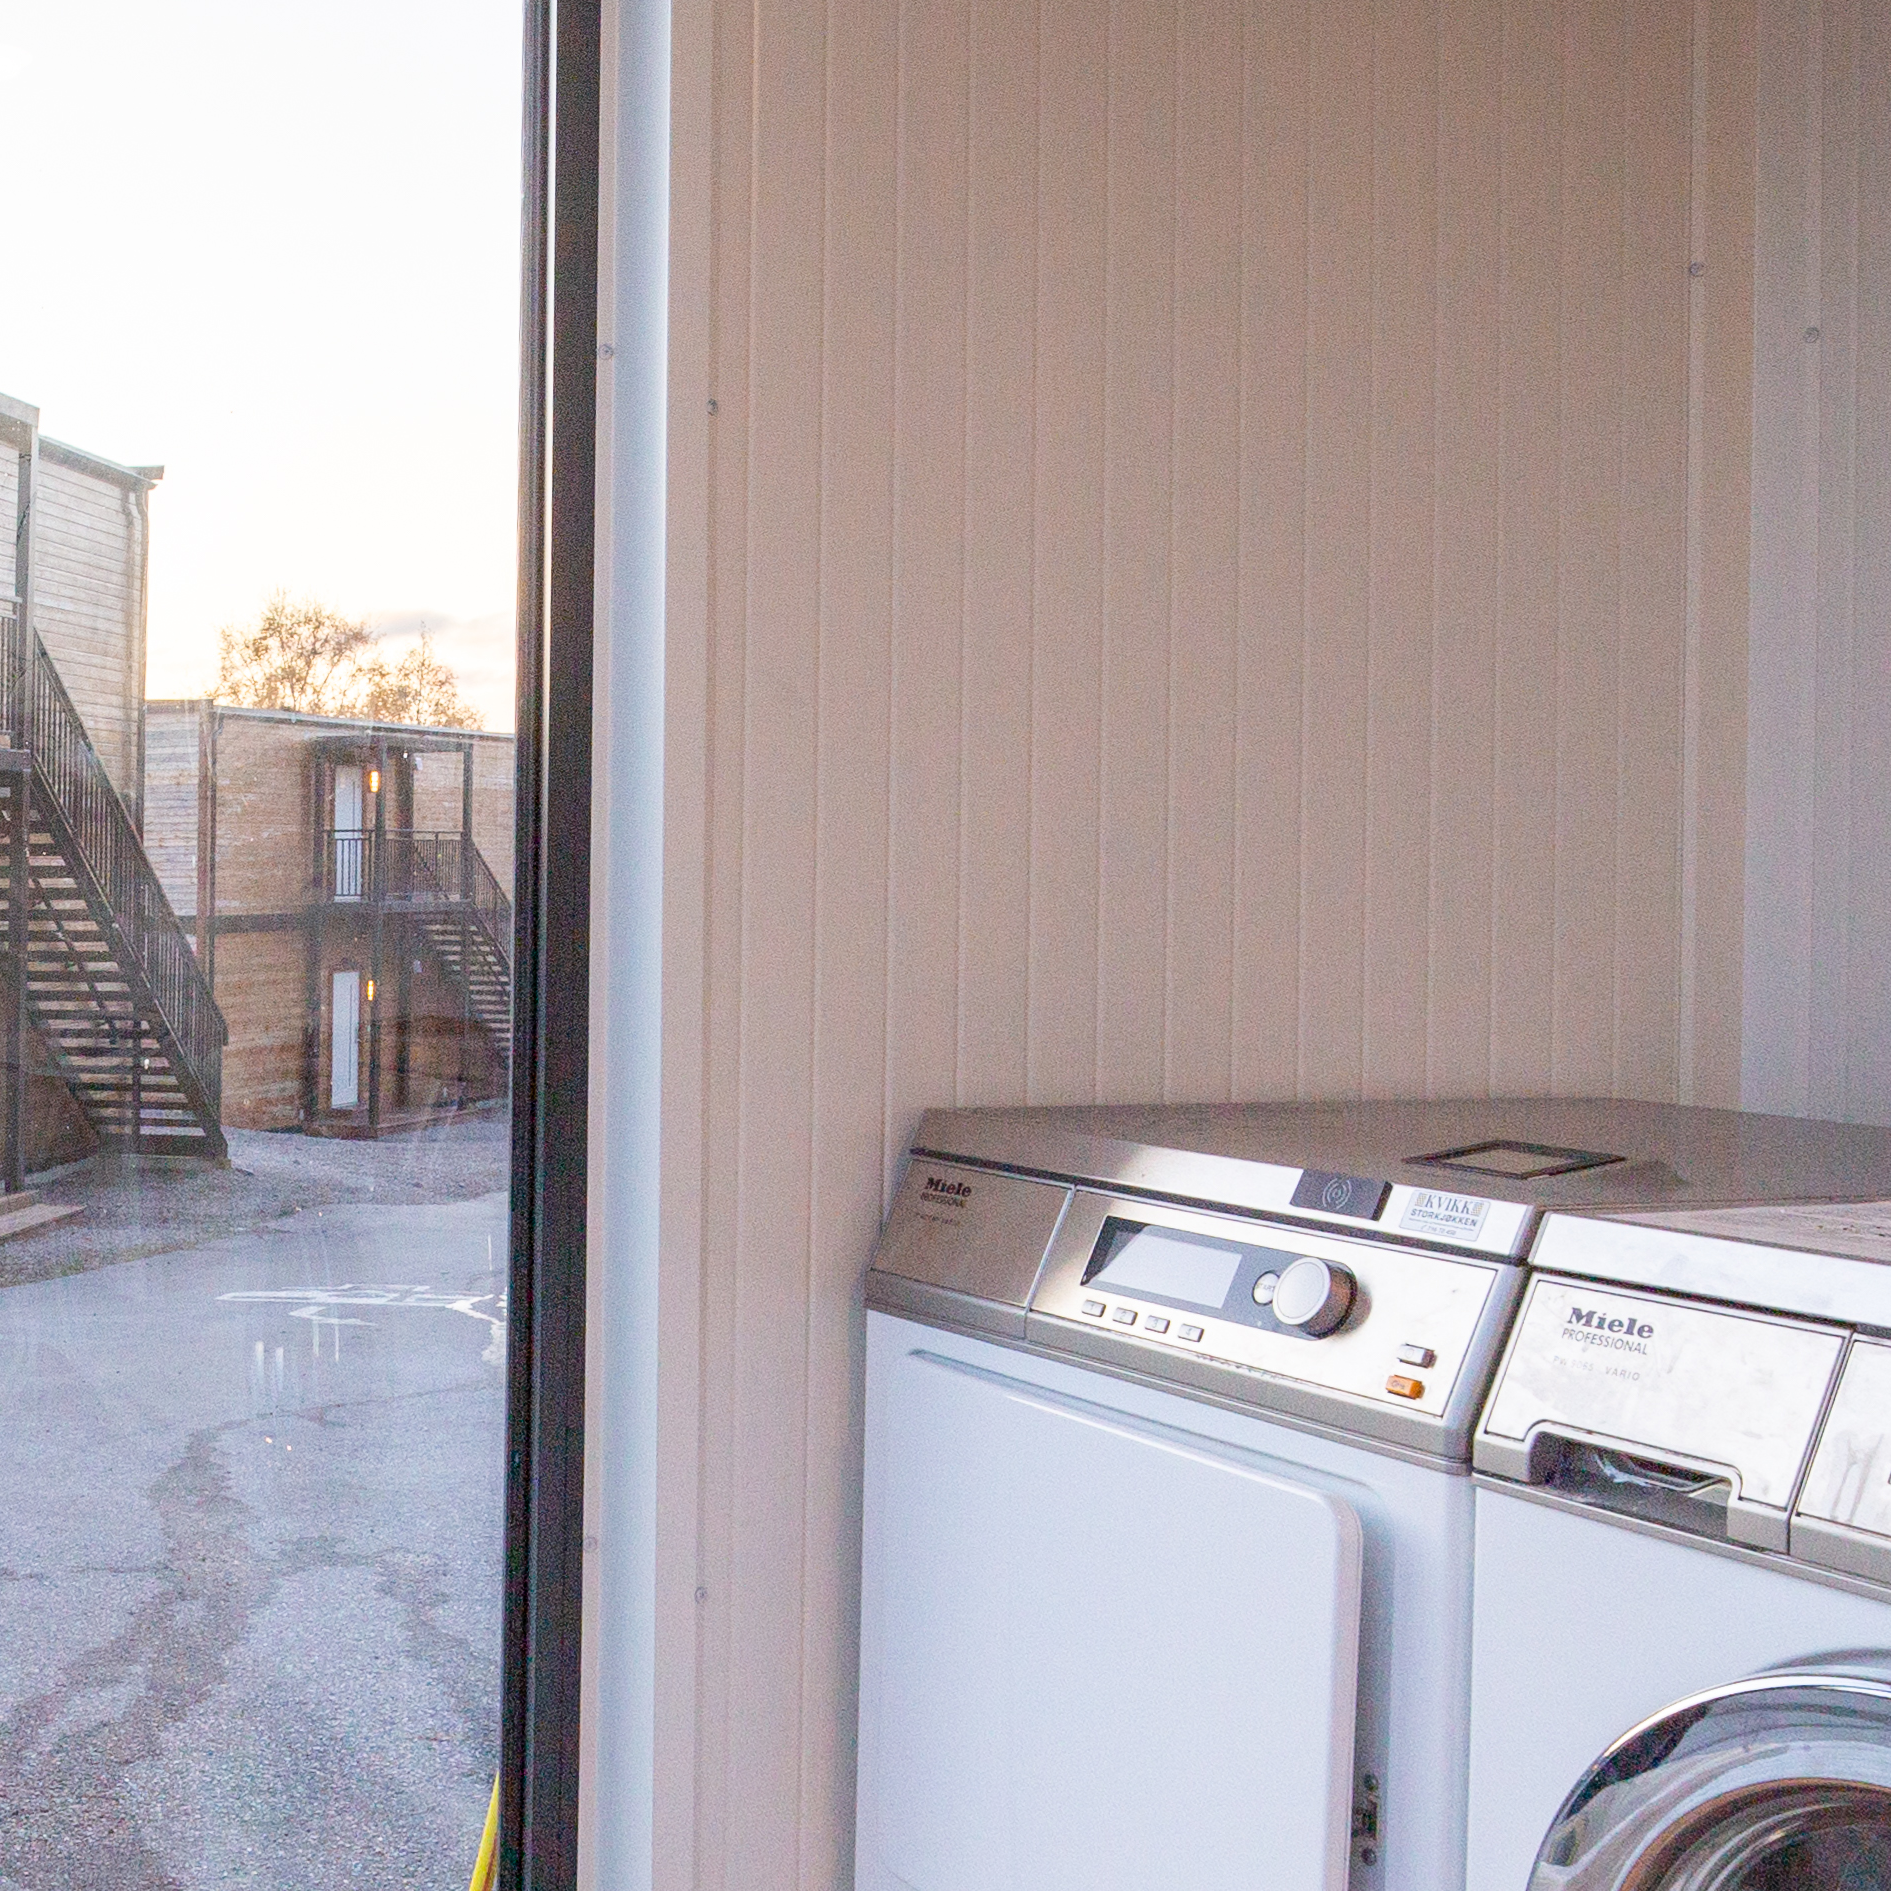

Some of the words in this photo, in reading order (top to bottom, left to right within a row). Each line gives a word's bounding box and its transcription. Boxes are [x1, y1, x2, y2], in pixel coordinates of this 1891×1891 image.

[925, 1177, 972, 1197] Miele
[1425, 1194, 1473, 1214] KVIKK
[1410, 1208, 1478, 1227] STORKJØKKEN
[1119, 1311, 1126, 1320] 2
[1152, 1319, 1158, 1328] 3
[1567, 1307, 1654, 1339] Miele
[1561, 1328, 1648, 1355] PROFESSIONAL
[1605, 1365, 1641, 1381] VARIO
